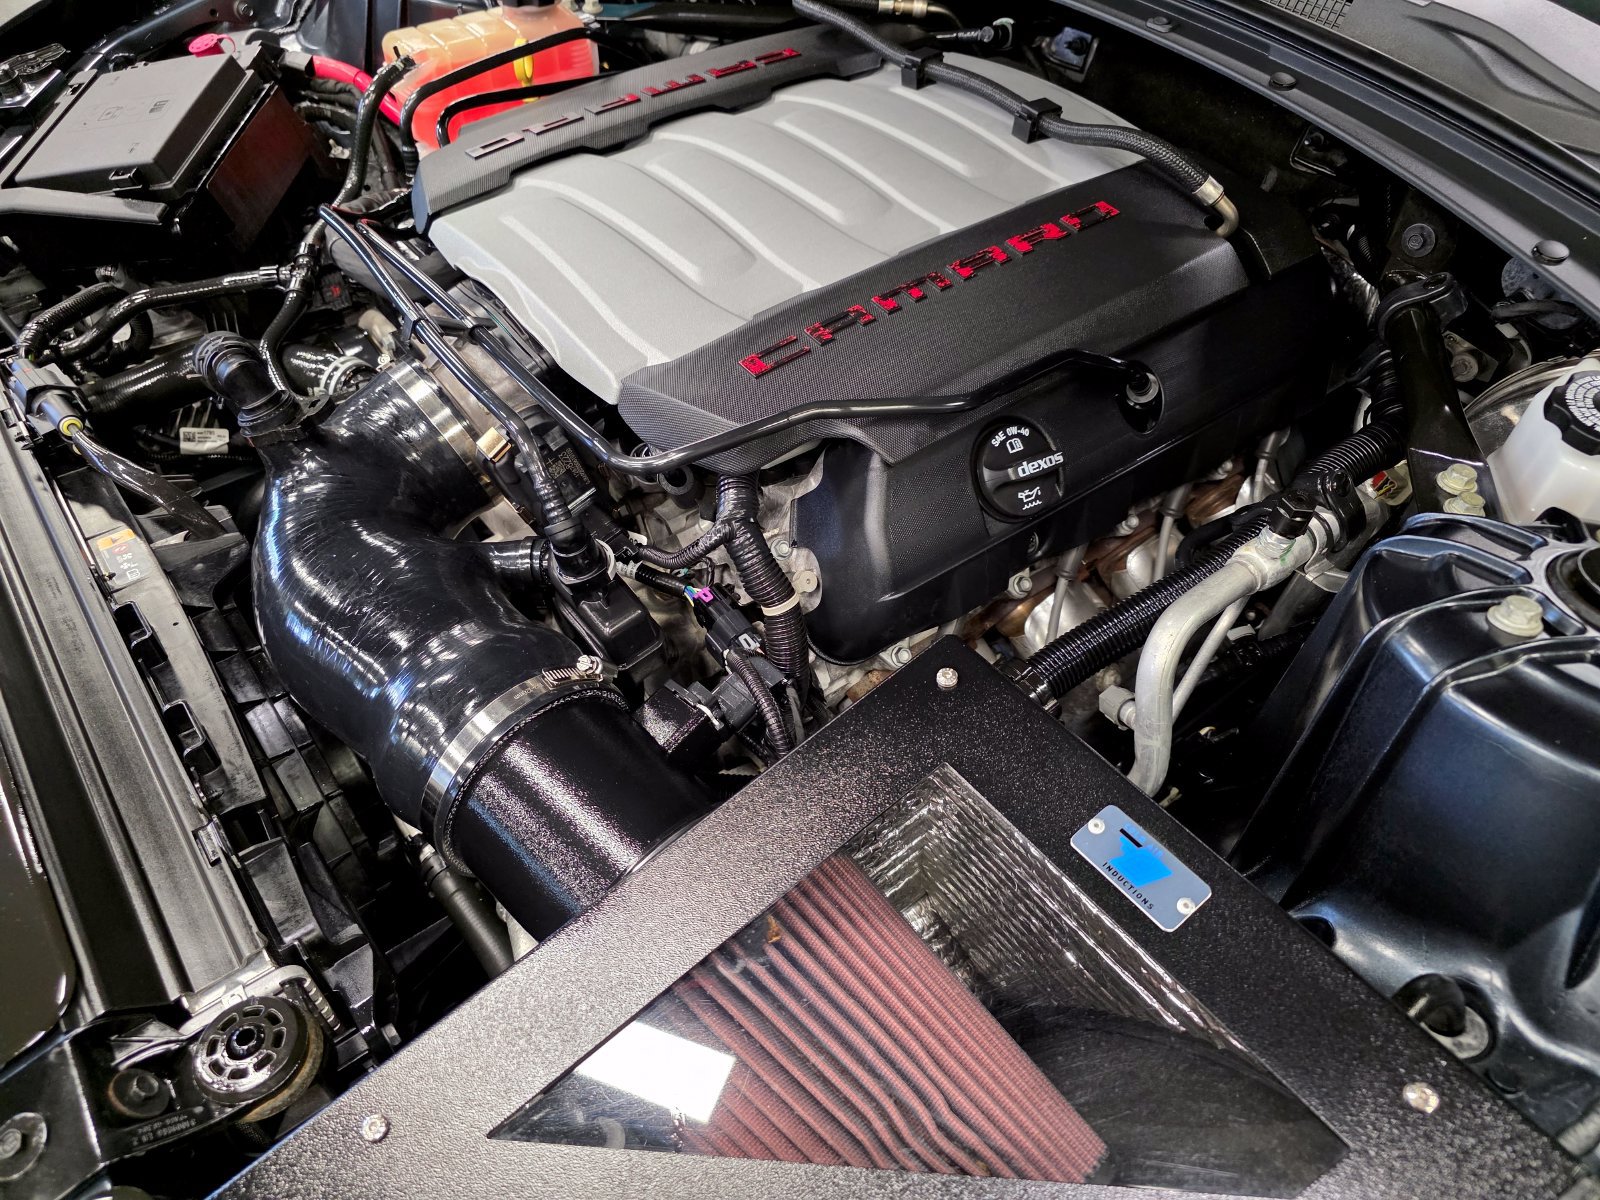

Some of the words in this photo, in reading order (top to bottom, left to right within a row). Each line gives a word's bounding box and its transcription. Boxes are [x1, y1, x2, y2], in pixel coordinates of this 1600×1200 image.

[738, 200, 1121, 378] CAMARO
[991, 431, 1006, 447] SAE
[1006, 426, 1030, 437] 0W-40
[1017, 452, 1064, 478] dexos
[1102, 861, 1154, 910] INDUCTIONS
